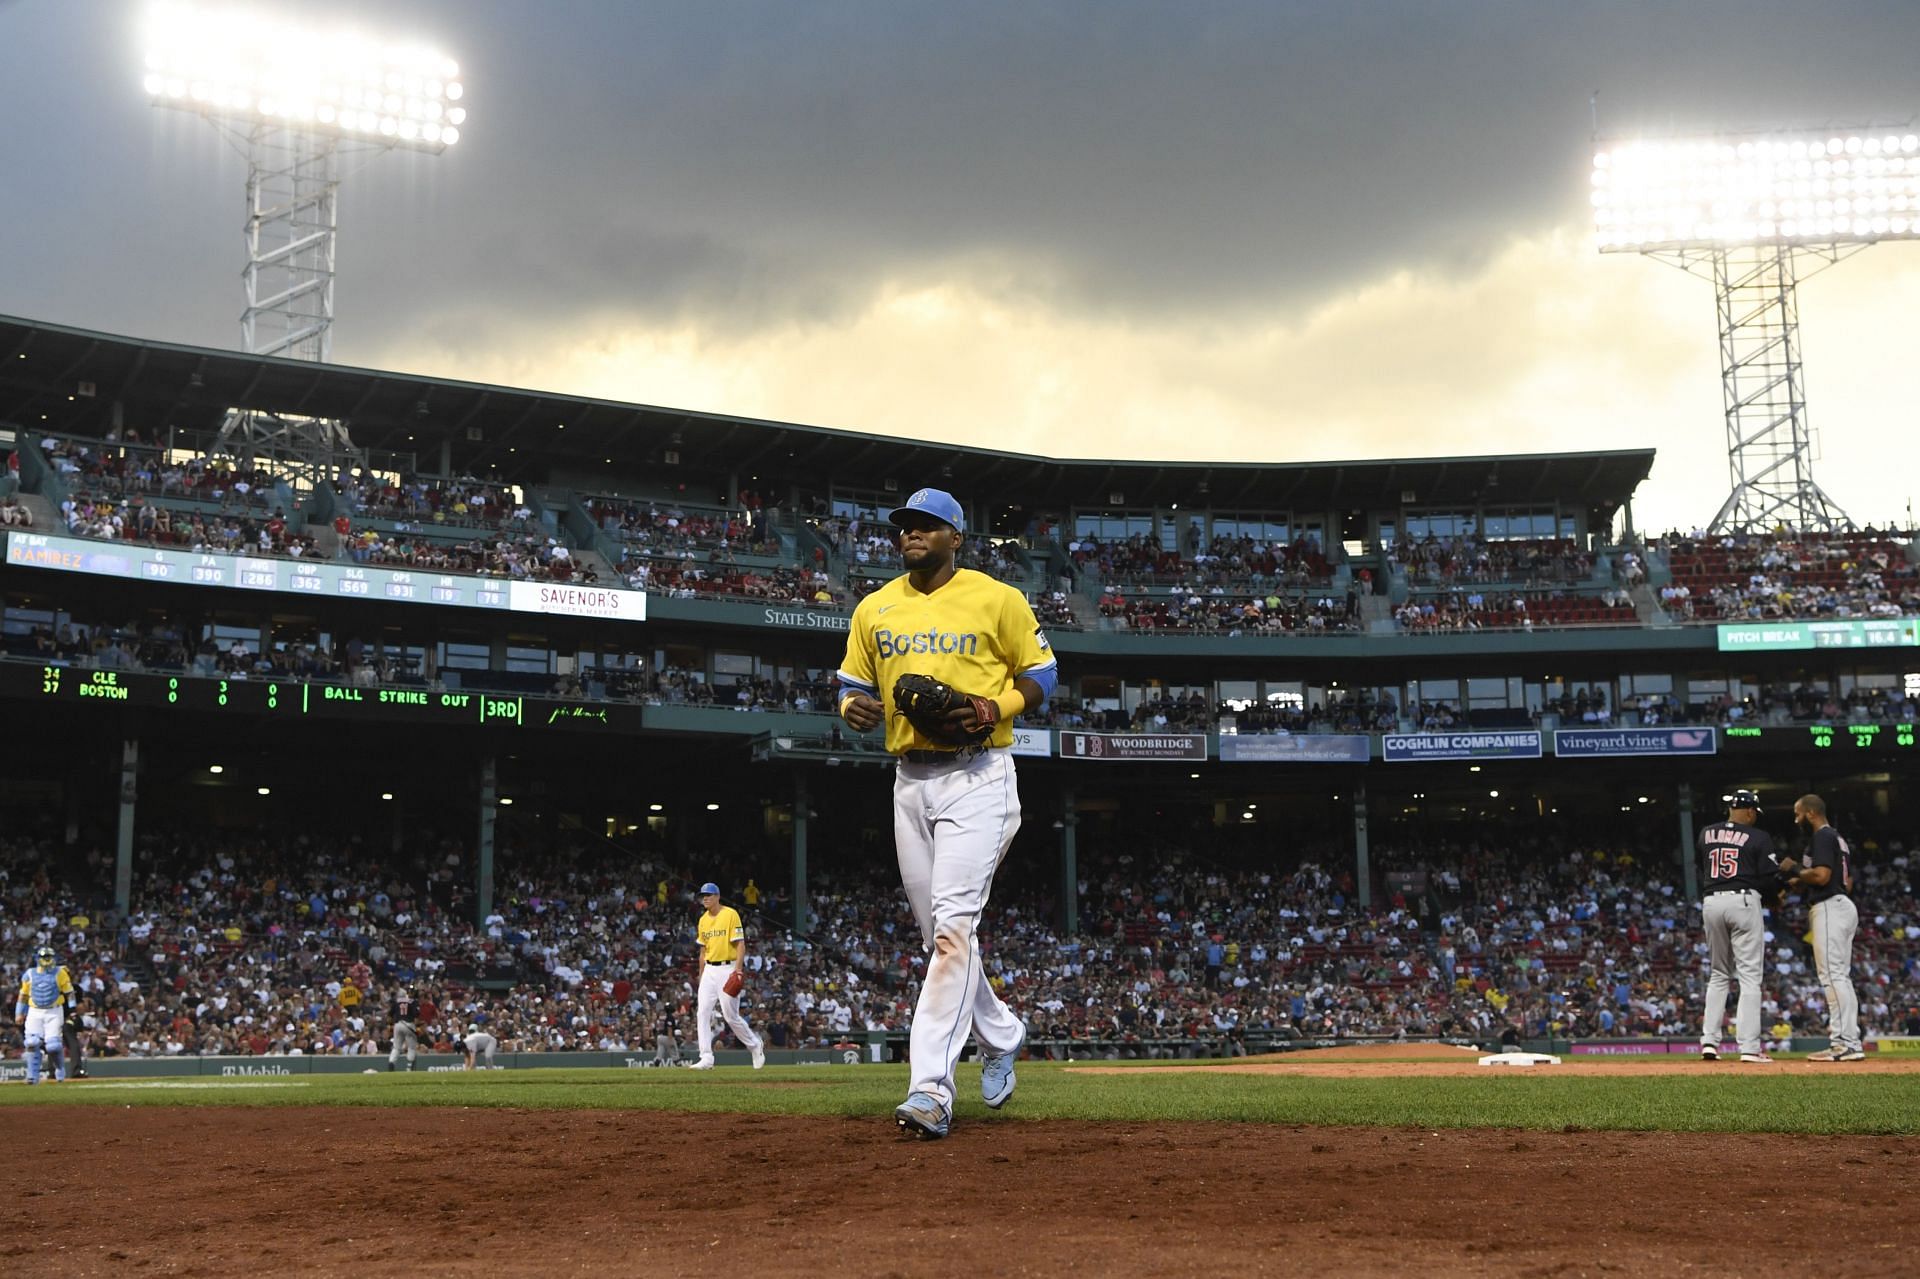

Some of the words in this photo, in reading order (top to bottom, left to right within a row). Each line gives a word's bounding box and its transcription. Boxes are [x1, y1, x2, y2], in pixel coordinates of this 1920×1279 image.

[12, 548, 82, 568] RAMIREZ
[156, 552, 163, 562] G
[202, 556, 216, 566] PA
[150, 563, 168, 577] 90
[250, 560, 268, 571] AVG
[298, 565, 317, 575] OBP
[196, 568, 222, 582] 390
[346, 569, 363, 579] SLG
[393, 573, 411, 583] OPS
[293, 576, 320, 590] .362
[441, 578, 452, 586] HR
[485, 581, 499, 591] RBI
[440, 589, 451, 600] 19
[541, 588, 619, 608] SAVENOR'S
[765, 609, 804, 626] STATE
[806, 612, 852, 630] STREET
[876, 627, 977, 660] Boston
[44, 667, 60, 680] 34
[93, 672, 117, 685] CLE
[170, 678, 177, 689] 0
[220, 681, 227, 692] 3
[269, 684, 277, 695] 0
[43, 681, 59, 694] 37
[80, 684, 128, 700] BOSTON
[169, 692, 177, 702] 0
[219, 694, 227, 705] 0
[268, 697, 276, 708] 0
[325, 687, 363, 700] BALL
[380, 691, 428, 704] STRIKE
[441, 694, 469, 707] OUT
[487, 701, 517, 718] 3RD
[1111, 738, 1193, 749] WOODBRIDGE
[1387, 737, 1449, 750] COGHLIN
[1452, 735, 1537, 748] COMPANIES
[1562, 734, 1625, 751] vineyard
[1628, 735, 1667, 746] vines
[1815, 736, 1831, 747] 40
[1856, 735, 1872, 746] 27
[1705, 830, 1749, 847] ALOMAR
[1710, 848, 1739, 879] 15
[239, 1065, 290, 1076] Mobile
